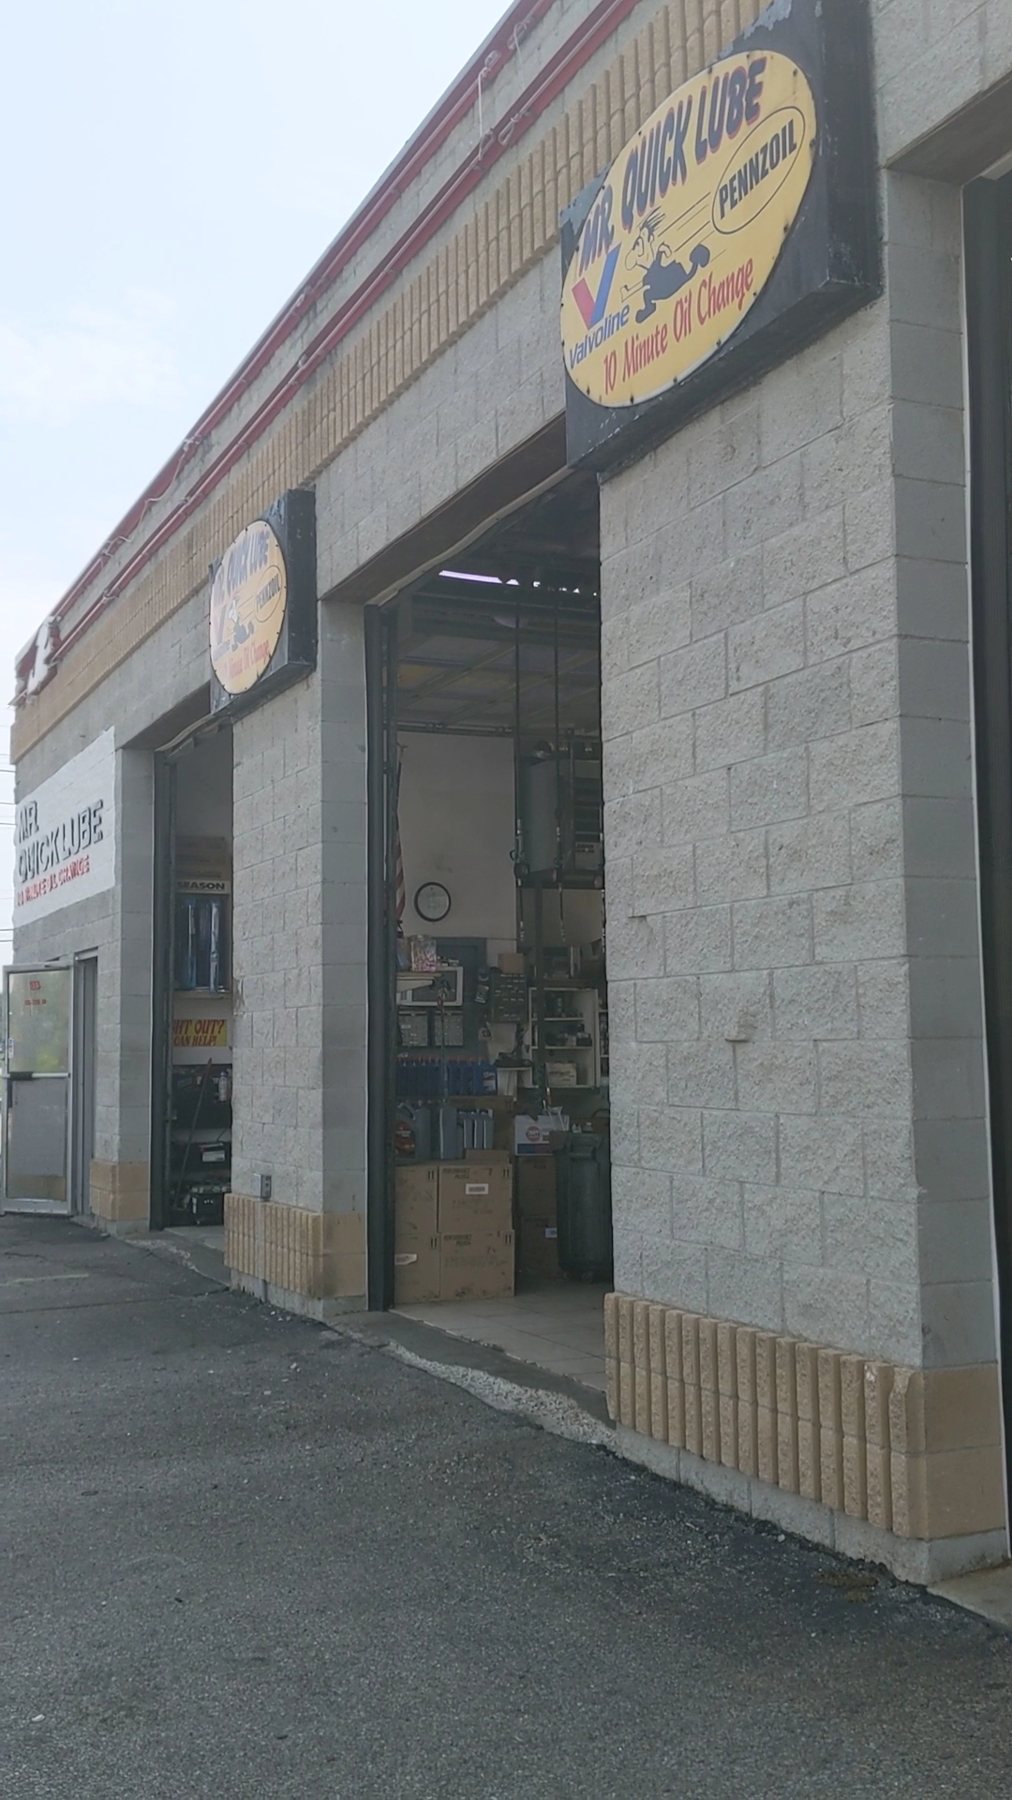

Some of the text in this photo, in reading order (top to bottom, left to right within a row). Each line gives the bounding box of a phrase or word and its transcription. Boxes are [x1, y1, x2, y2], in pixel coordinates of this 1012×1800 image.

[621, 94, 693, 232] QUICK
[695, 57, 767, 165] LUBE
[718, 119, 797, 220] PENNZOIL
[570, 304, 630, 370] Valvoline
[603, 258, 754, 395] 10 Minute Oil Change
[18, 798, 104, 884] QUICK LUBE
